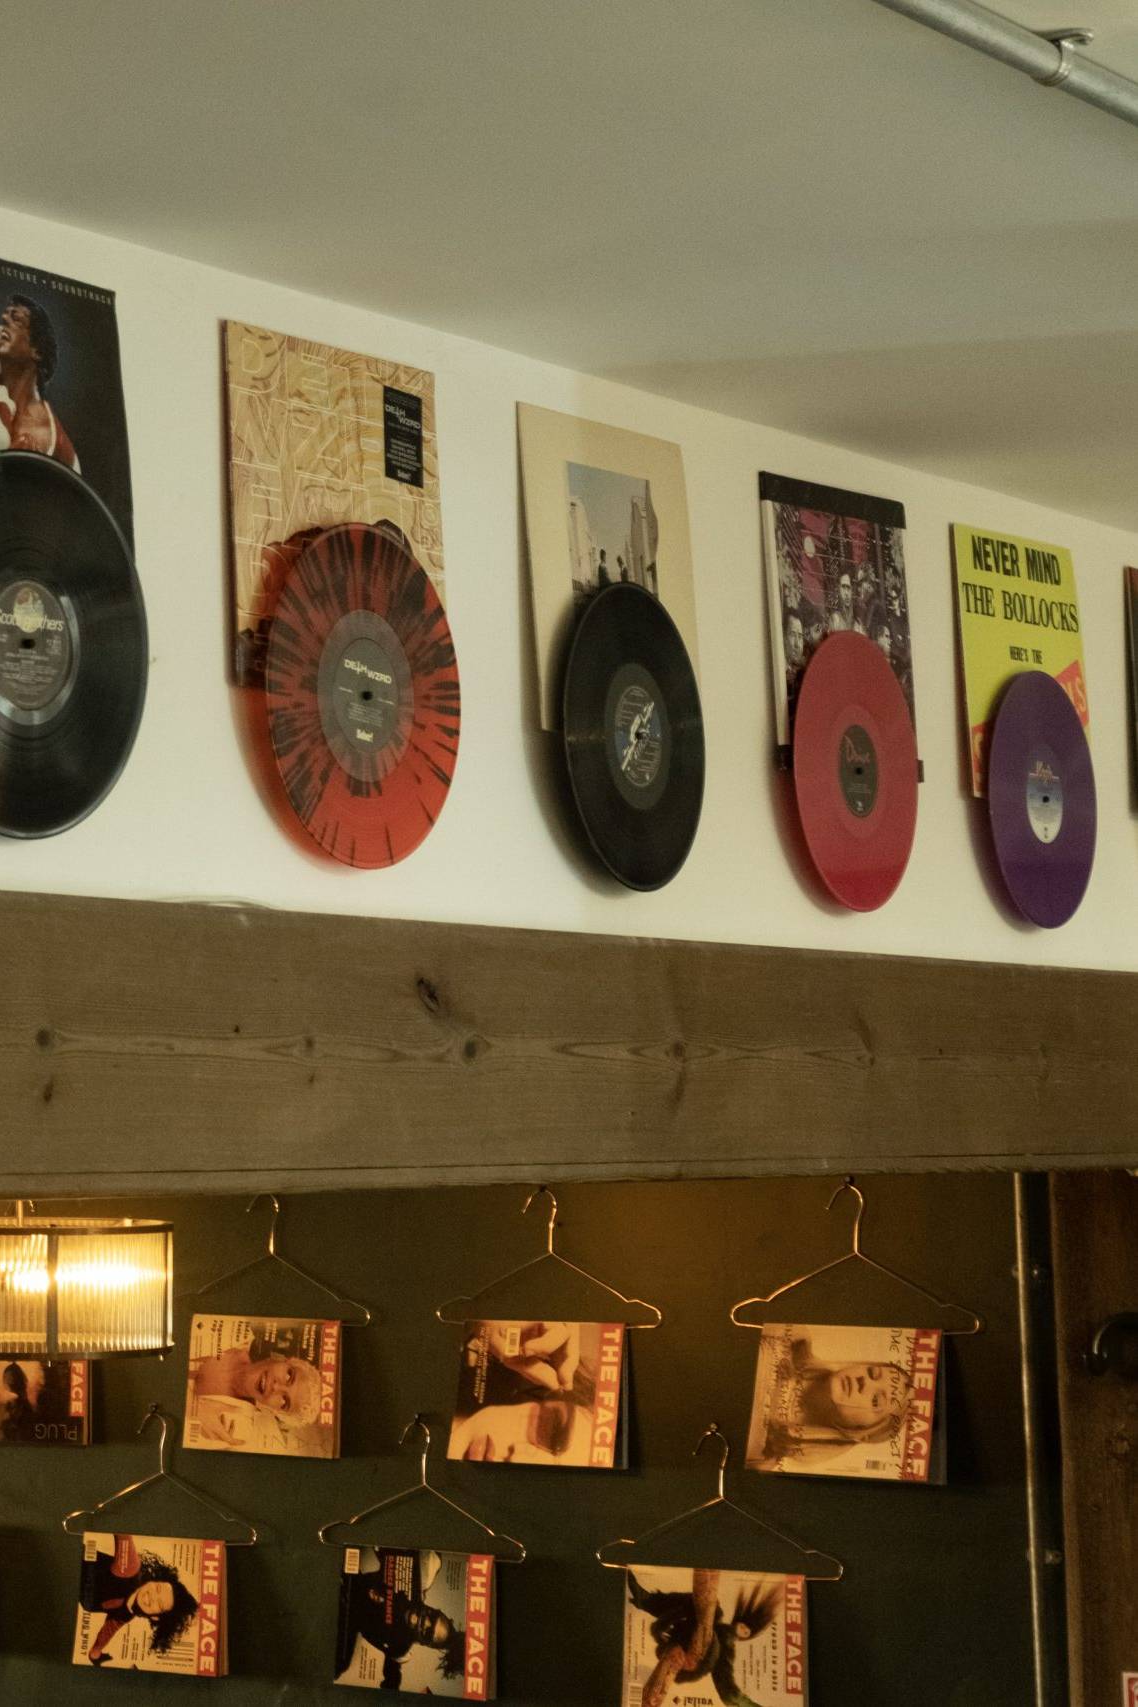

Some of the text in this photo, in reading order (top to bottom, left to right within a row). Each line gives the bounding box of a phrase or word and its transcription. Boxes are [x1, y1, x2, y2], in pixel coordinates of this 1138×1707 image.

[962, 581, 1080, 633] THE BOLLOCKS
[971, 534, 1061, 586] NEVER MIND
[70, 1362, 84, 1413] FACE
[320, 1326, 338, 1425] THE FACE
[592, 1329, 620, 1464] THE FACE
[910, 1333, 938, 1477] THE FACE
[34, 1423, 78, 1441] PLUG
[200, 1544, 220, 1673] THE FACE
[467, 1559, 488, 1695] THE FACE
[786, 1579, 803, 1695] THE FACE
